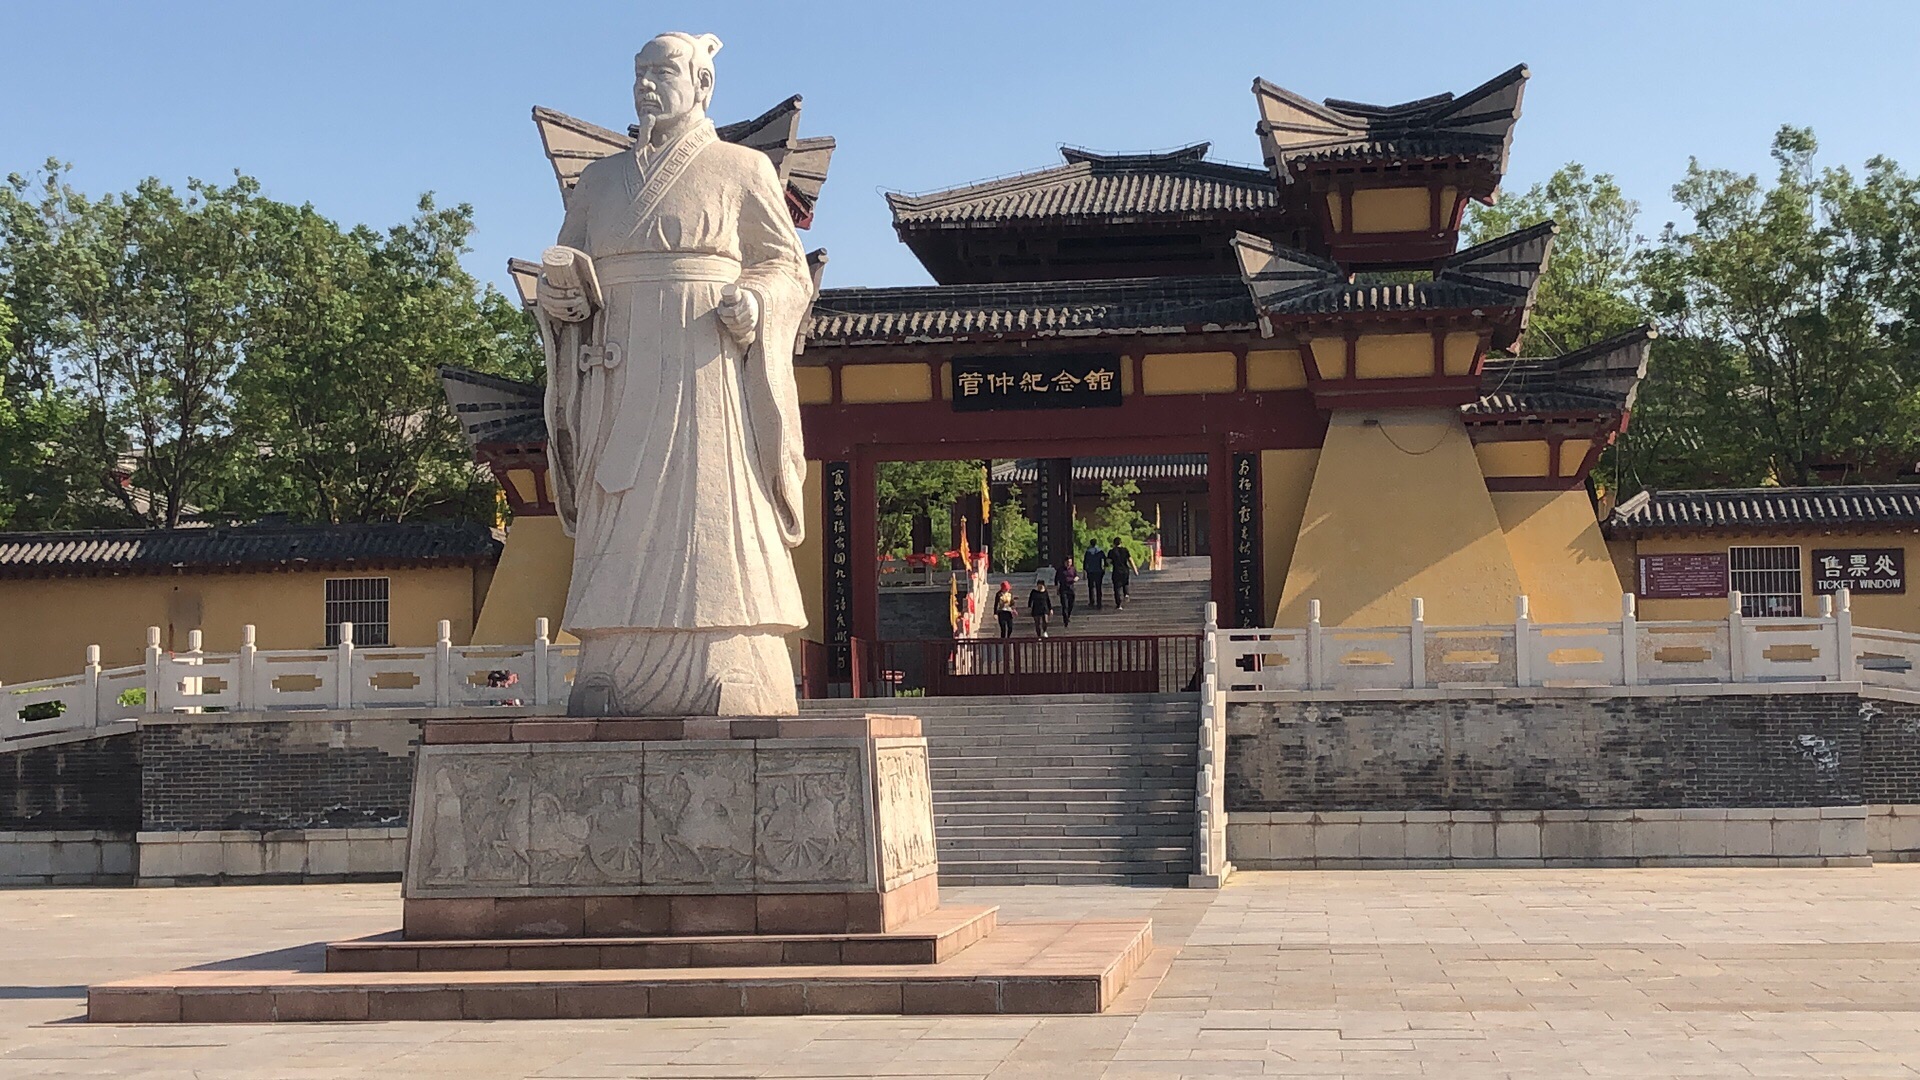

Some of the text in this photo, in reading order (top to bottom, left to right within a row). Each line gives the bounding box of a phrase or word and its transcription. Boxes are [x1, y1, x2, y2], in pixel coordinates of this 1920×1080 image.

[1820, 554, 1898, 578] 售票处
[1818, 579, 1901, 590] TICKET WINDOW
